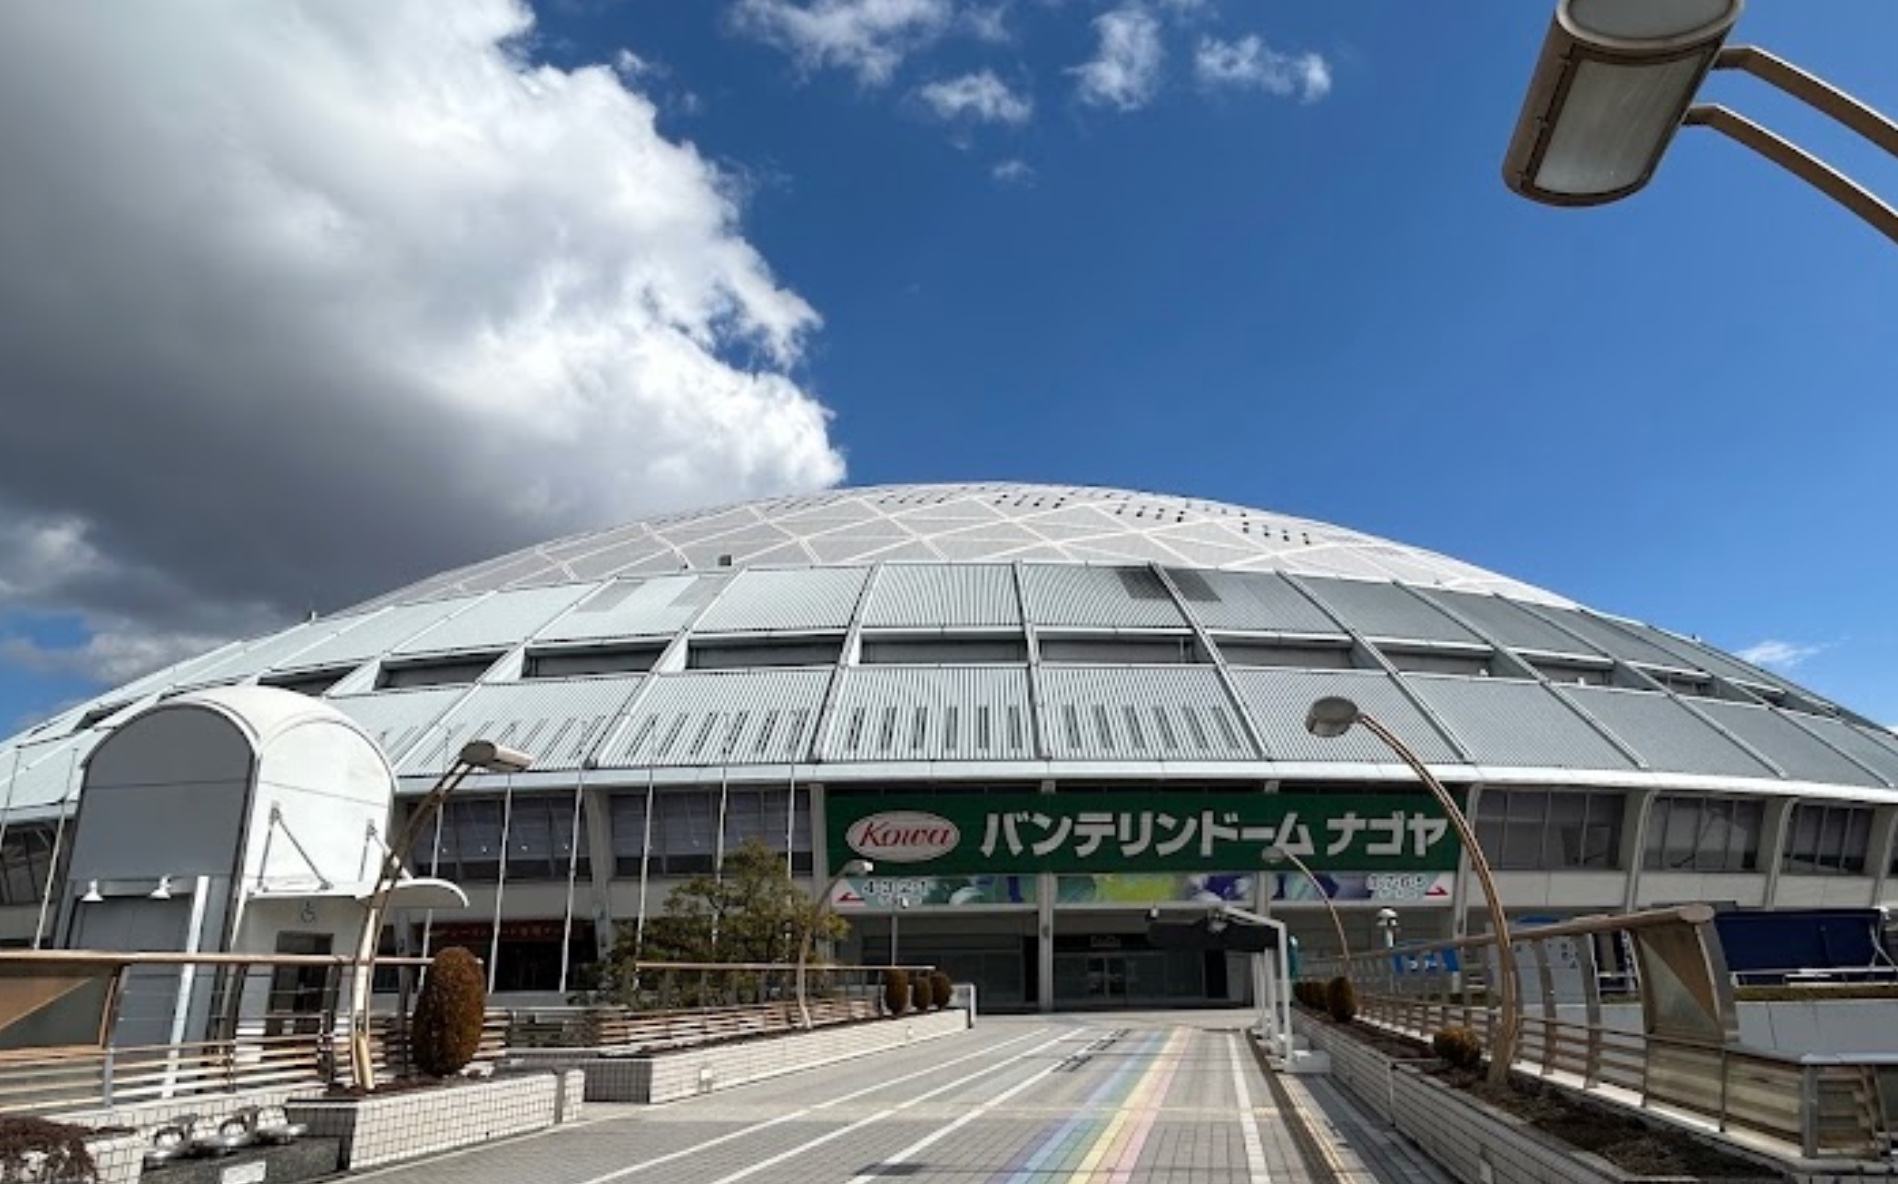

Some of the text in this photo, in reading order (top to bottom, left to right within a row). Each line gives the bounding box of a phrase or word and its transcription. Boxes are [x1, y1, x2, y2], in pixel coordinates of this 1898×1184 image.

[859, 821, 950, 848] Kowa
[980, 810, 1448, 858] バンテリンドーム ナゴヤ
